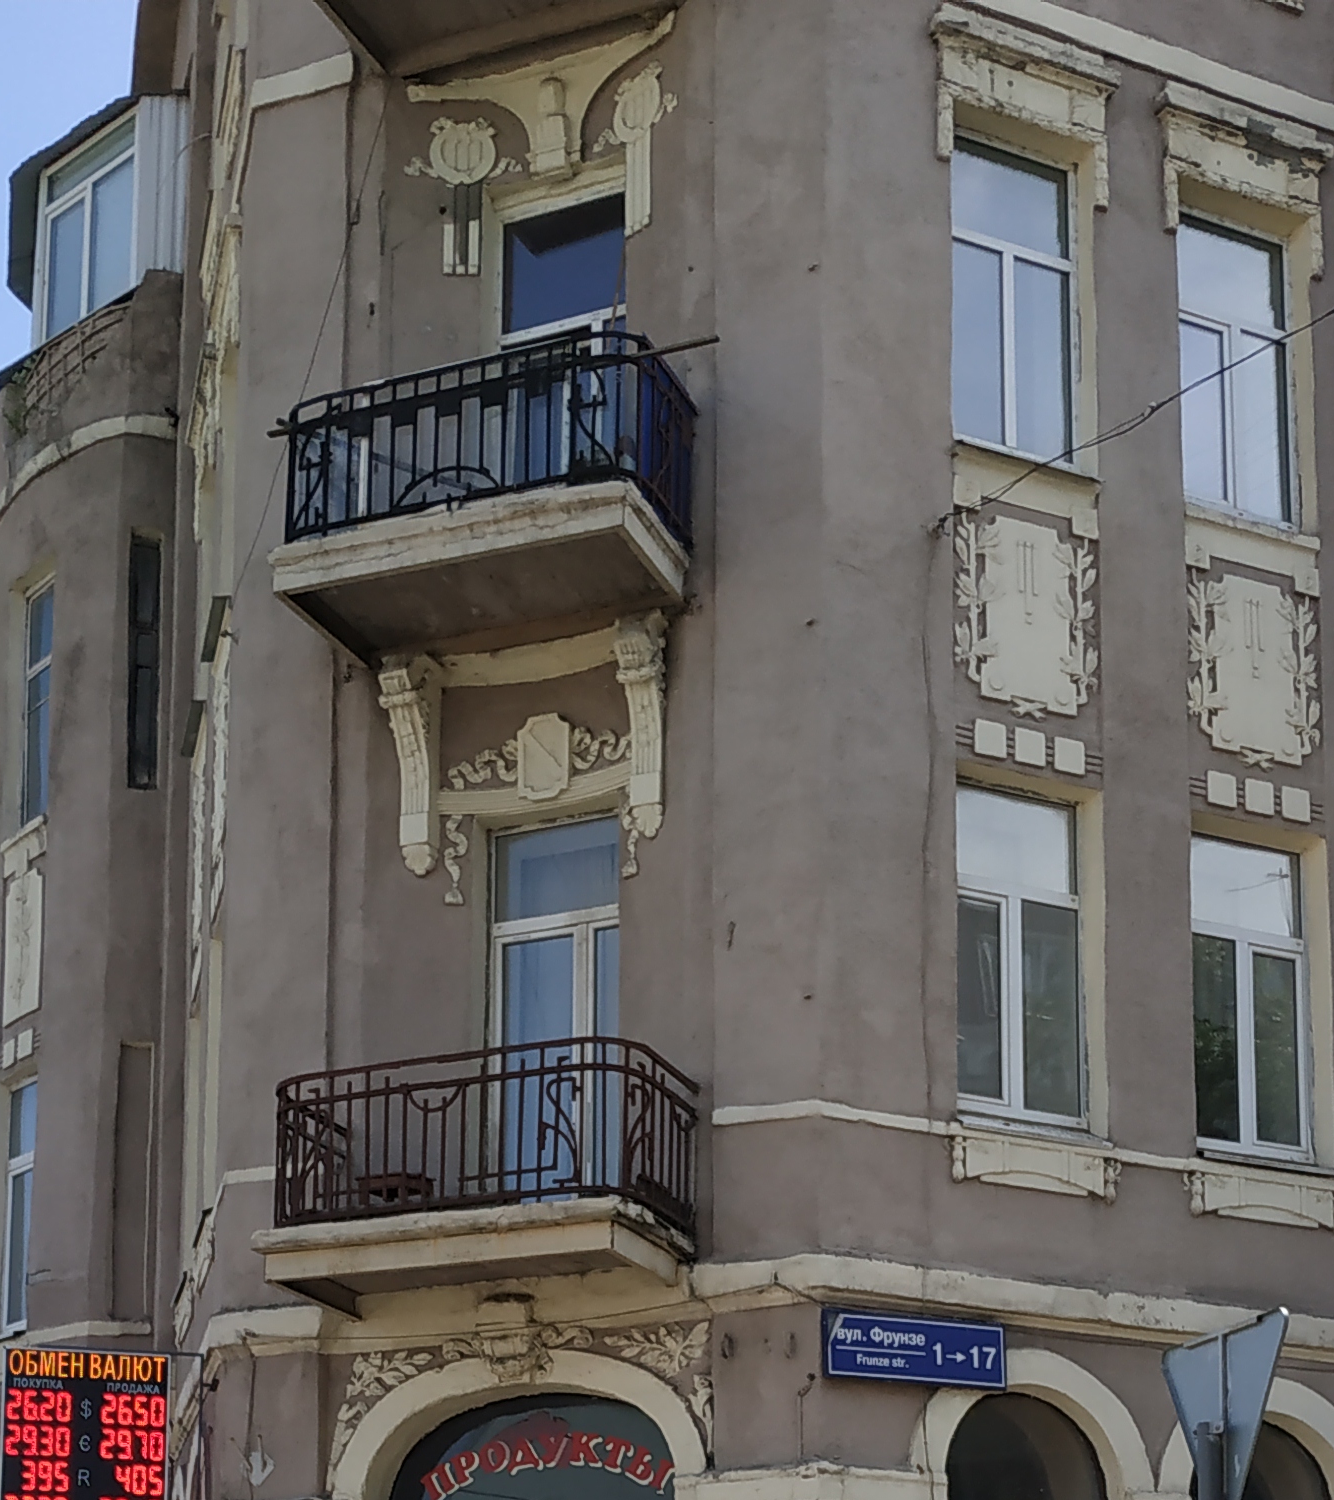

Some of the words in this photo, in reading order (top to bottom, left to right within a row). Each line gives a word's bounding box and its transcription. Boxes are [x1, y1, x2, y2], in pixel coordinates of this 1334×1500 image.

[836, 1327, 867, 1344] вул.
[869, 1325, 926, 1348] Фрунзе
[9, 1350, 84, 1378] ОБМЕН
[89, 1354, 166, 1383] ВАЛЮТ
[856, 1353, 890, 1367] Frunze
[891, 1356, 910, 1369] str.
[932, 1342, 944, 1366] 1
[968, 1345, 997, 1370] 17
[13, 1377, 64, 1390] ПОКУПКА
[106, 1382, 161, 1395] ПРОДАЖА
